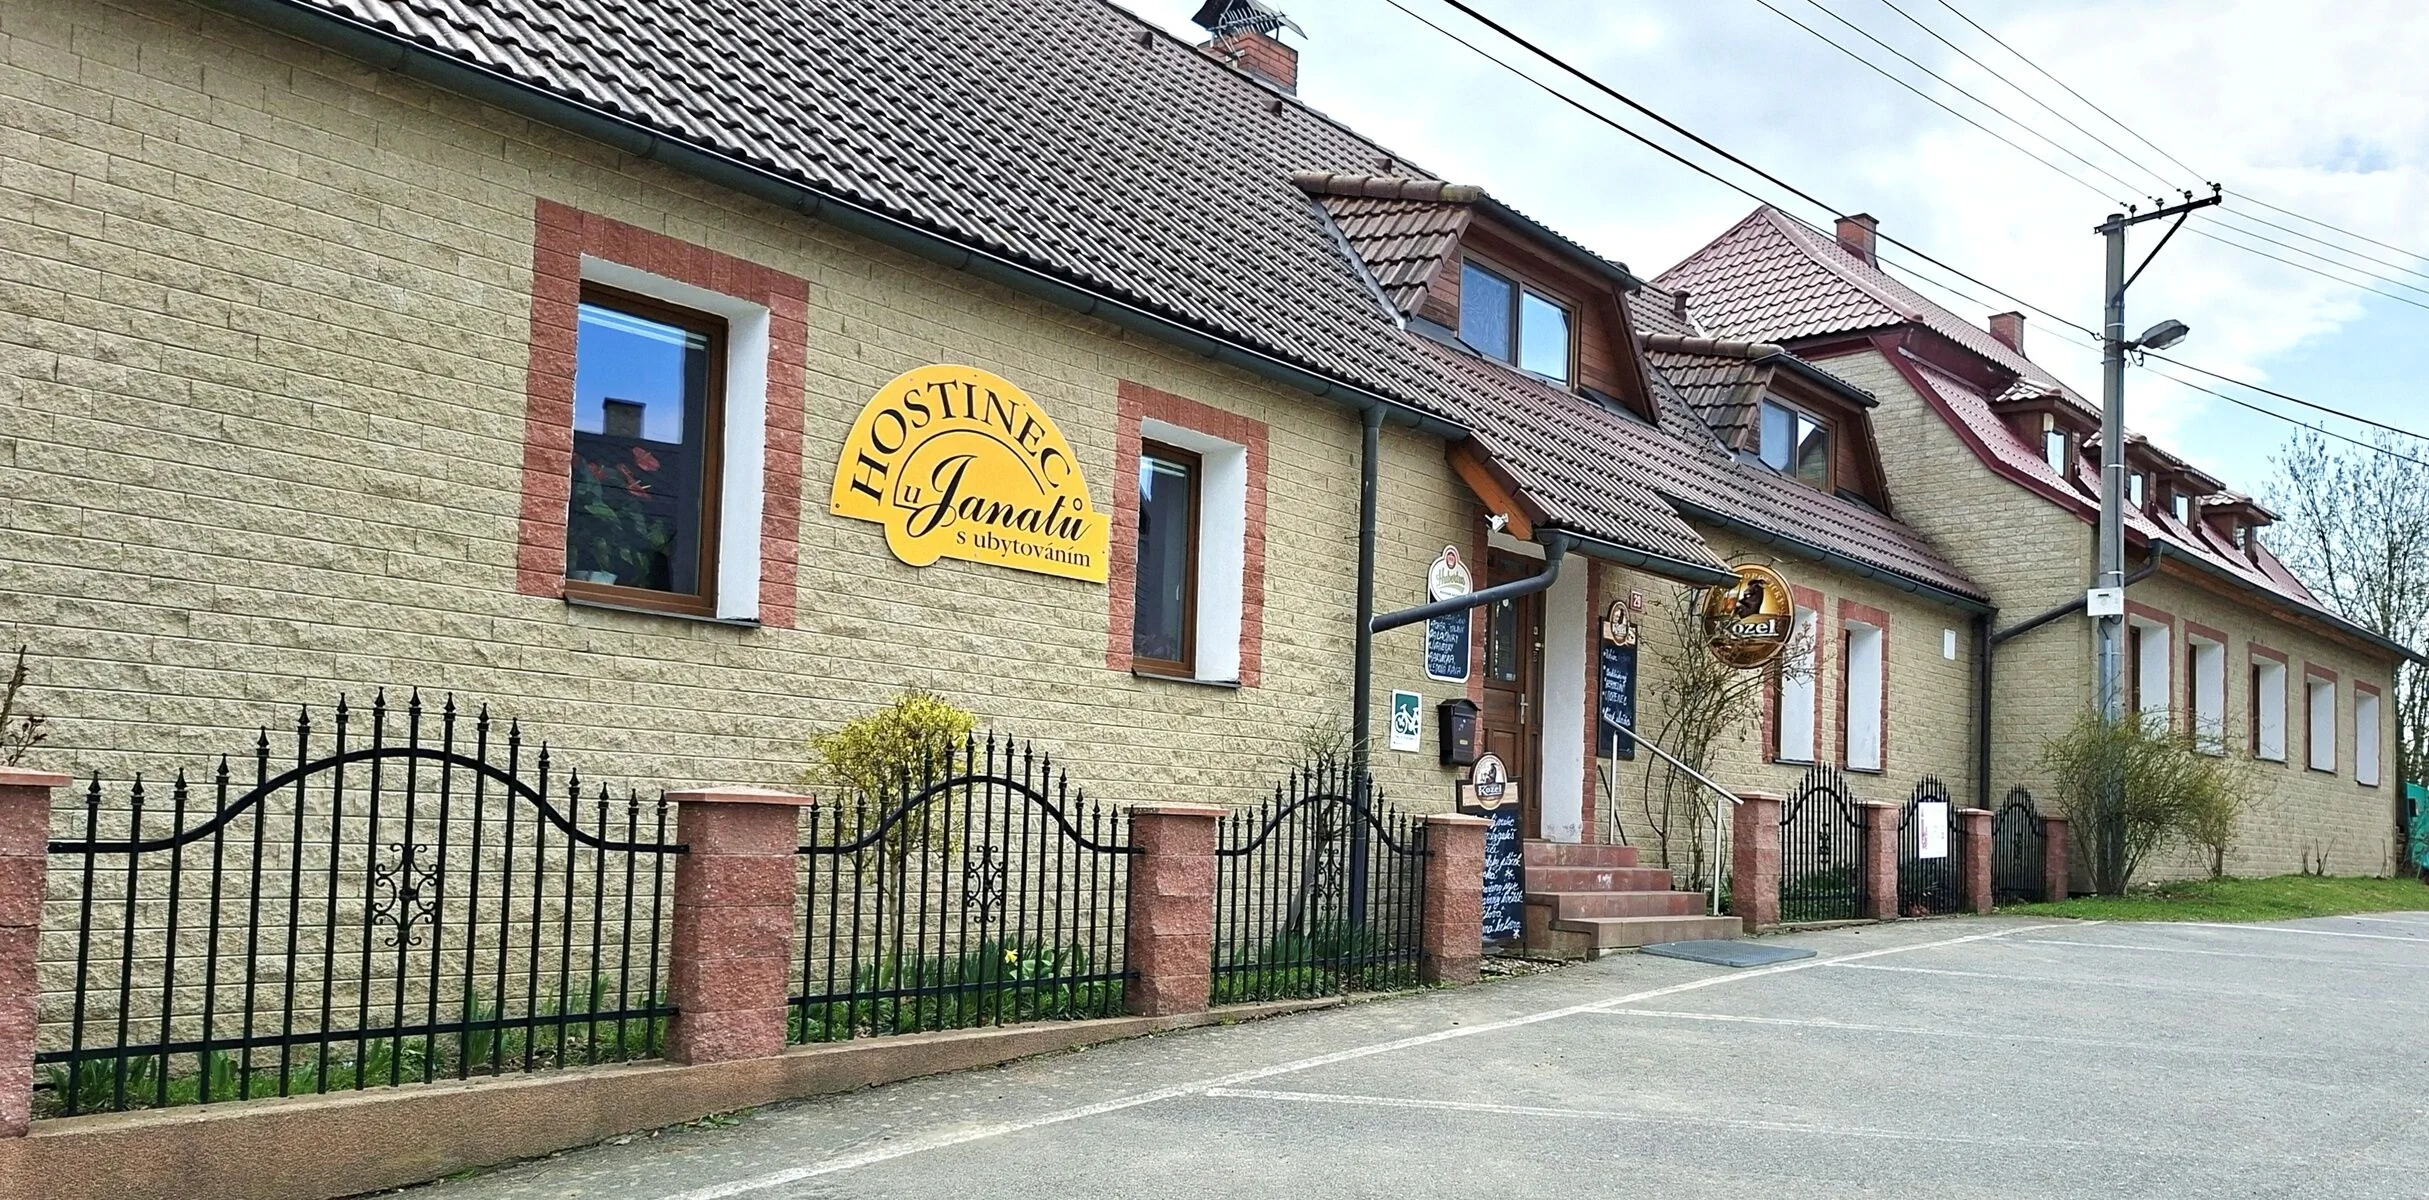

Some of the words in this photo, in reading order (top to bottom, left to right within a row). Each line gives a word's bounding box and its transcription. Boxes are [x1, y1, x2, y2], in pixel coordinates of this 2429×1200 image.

[850, 378, 1071, 507] HOSTINEC
[903, 485, 922, 505] u
[906, 454, 1093, 542] Janatů
[956, 532, 967, 545] s
[974, 534, 1091, 568] ubytováním
[1478, 784, 1502, 797] Kozel
